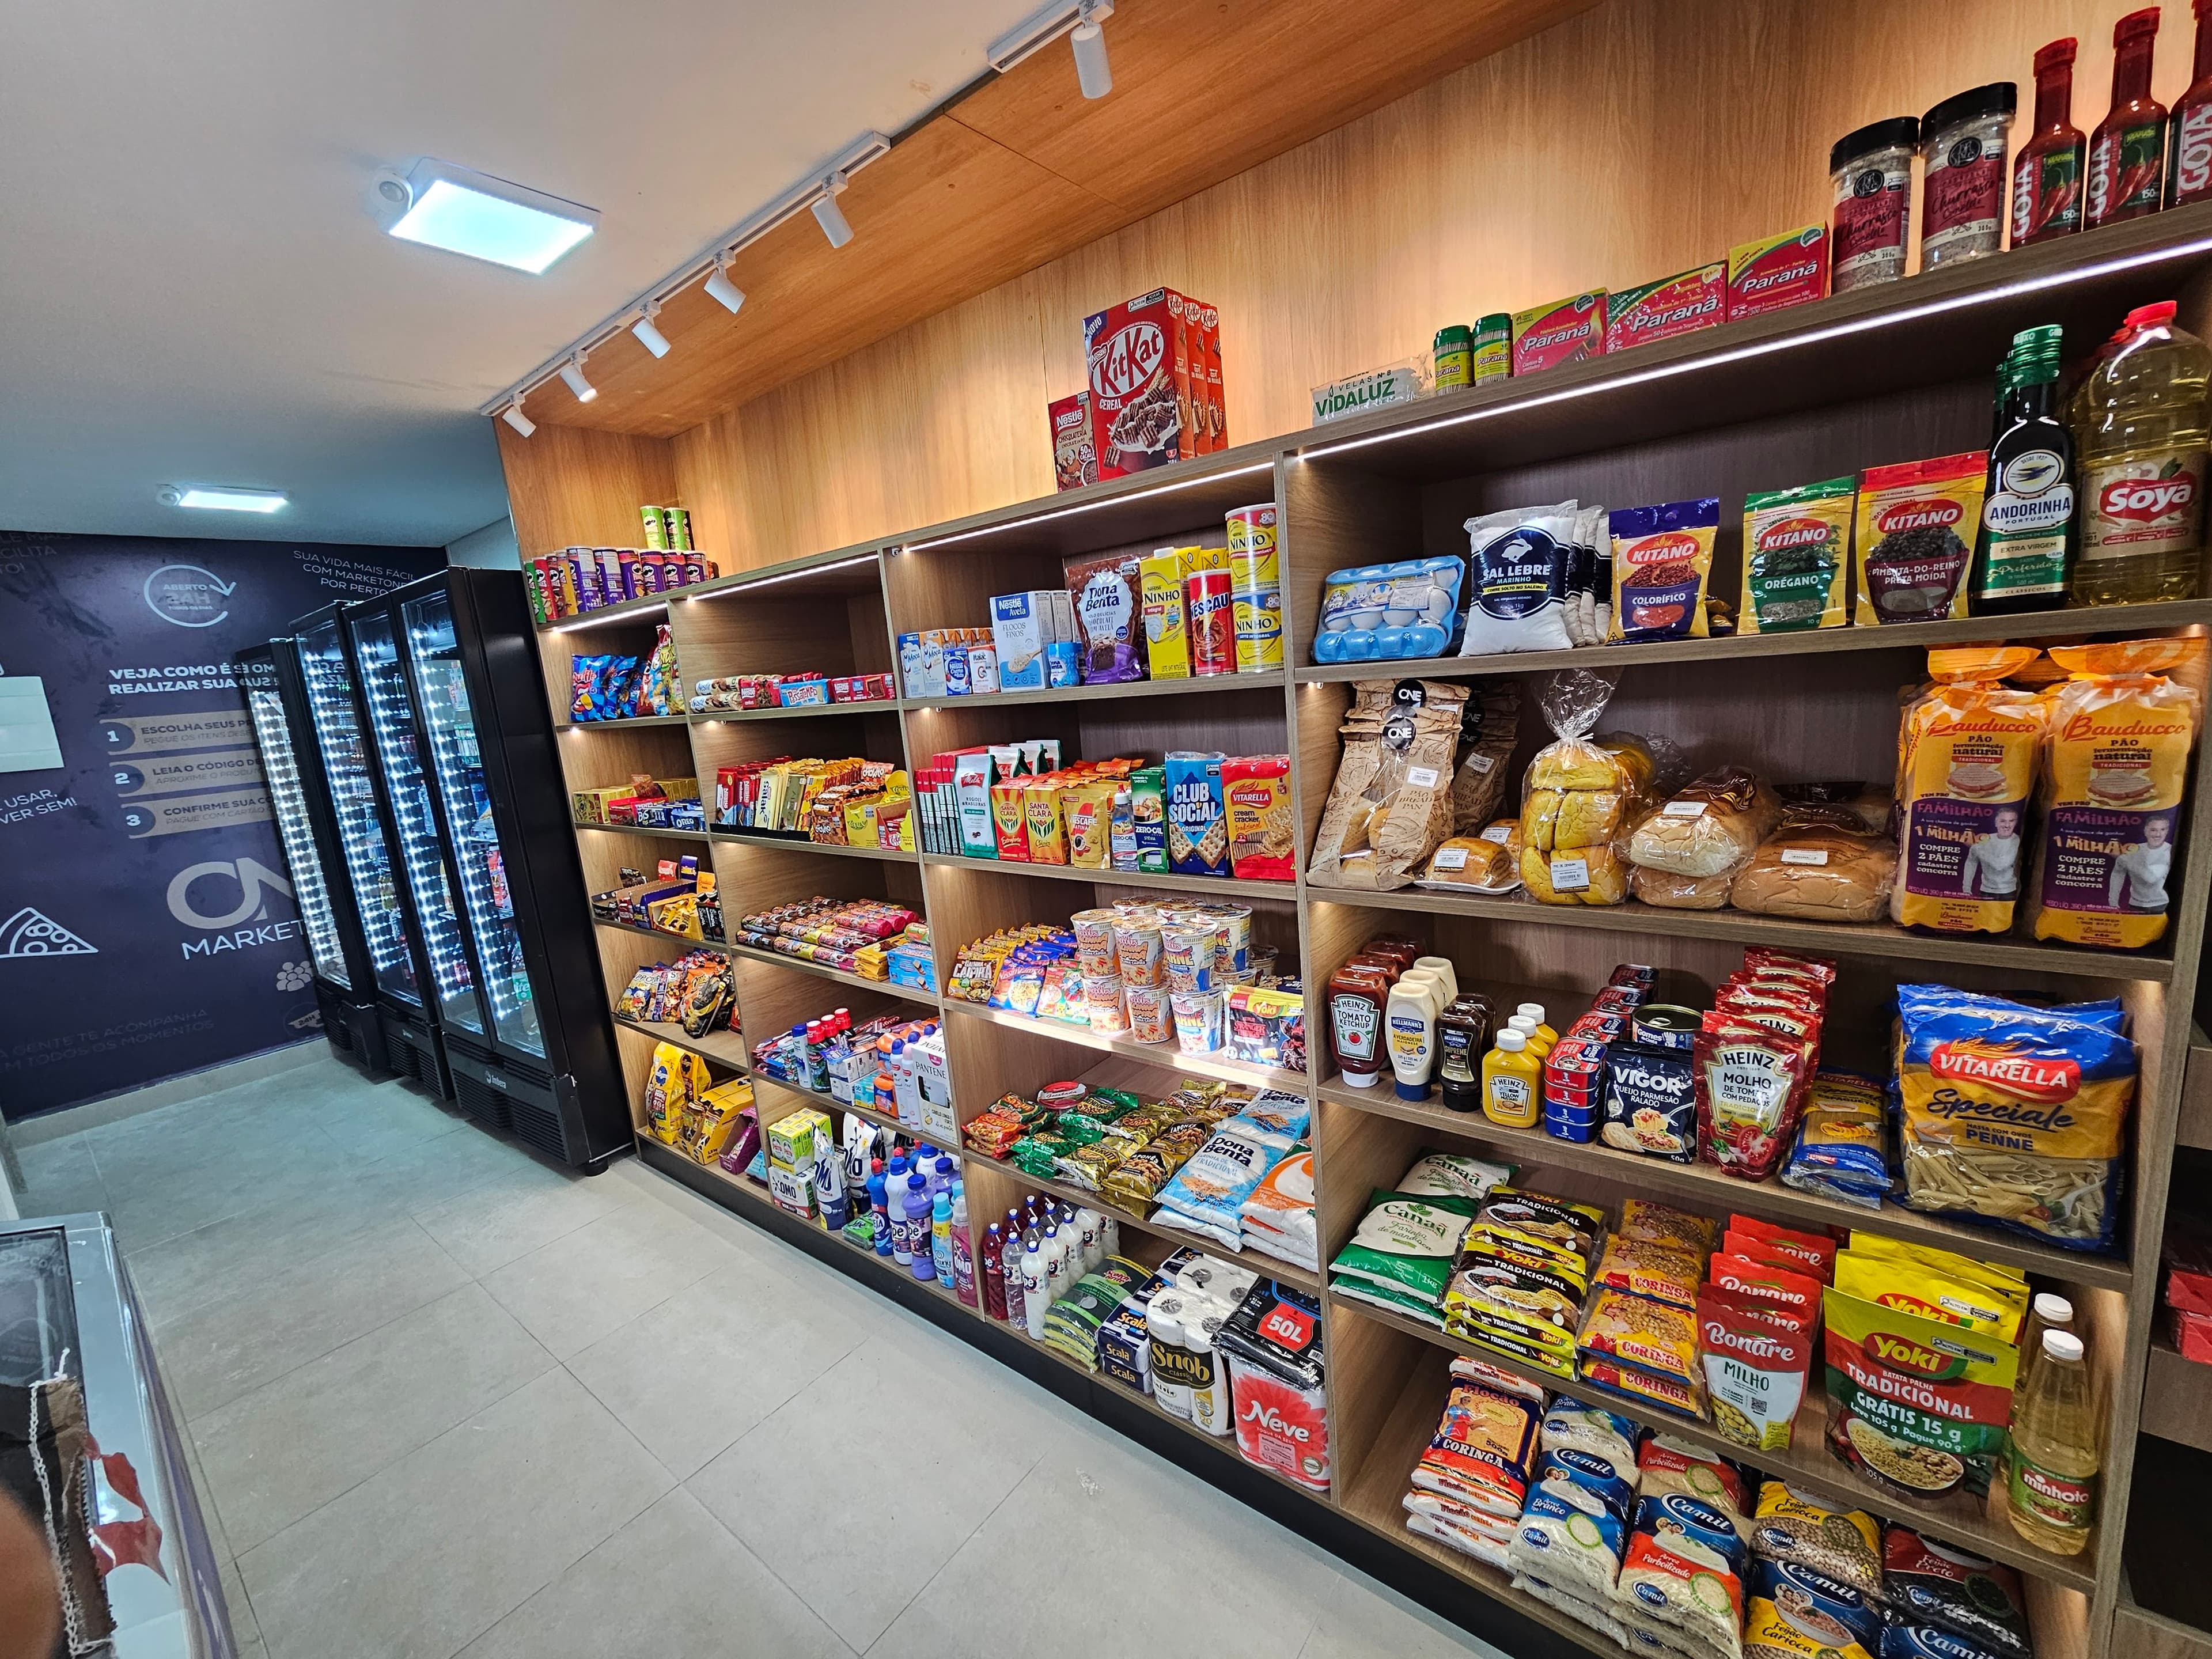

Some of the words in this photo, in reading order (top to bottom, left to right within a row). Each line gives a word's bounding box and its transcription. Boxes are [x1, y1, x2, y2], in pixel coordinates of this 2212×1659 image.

[1743, 260, 1819, 293] Paraná
[1633, 295, 1718, 332] Paraná
[1087, 316, 1102, 338] NOVO
[1524, 322, 1591, 351] Paraná
[1100, 326, 1161, 396] KitKat
[1338, 376, 1372, 392] VELAS
[1099, 397, 1122, 410] CEREAL
[1056, 408, 1083, 427] Nestlé
[2106, 482, 2191, 513] Soya
[1990, 495, 2071, 521] ANDORINHA
[1883, 507, 1959, 532] KITANO
[2006, 514, 2055, 525] PORTUGAL
[1229, 533, 1266, 551] NINHO
[1764, 528, 1828, 548] KITANO
[2000, 543, 2025, 553] EXTRA
[2027, 541, 2056, 552] VIRGEM
[1633, 541, 1696, 563] KITANO
[294, 551, 319, 562] SUA
[323, 556, 351, 568] VIDA
[354, 563, 382, 575] MAIS
[387, 569, 415, 581] FÁCIL
[303, 564, 332, 575] COM
[1483, 568, 1505, 581] SAL
[1507, 565, 1551, 577] LEBRE
[1872, 559, 1961, 576] PIMENTA-DO-REINO
[1497, 575, 1531, 584] MARINHO
[1764, 575, 1819, 590] ORÉGANO
[1915, 571, 1946, 582] MOÍDA
[321, 578, 347, 589] POR
[350, 584, 389, 595] PERTO
[998, 598, 1022, 611] Nestlé
[1085, 593, 1120, 611] Benta
[1144, 589, 1180, 605] NINHO
[1632, 592, 1687, 606] COLORÍFICO
[1190, 593, 1229, 620] NESCAU
[1002, 622, 1026, 631] FLOCOS
[1005, 630, 1024, 639] FINOS
[109, 668, 162, 679] VEJA
[164, 665, 217, 677] COMO
[220, 663, 232, 675] É
[109, 680, 200, 695] REALIZAR
[202, 679, 237, 690] SUA
[107, 730, 119, 743] 1
[141, 724, 202, 734] ESCOLHA
[204, 721, 235, 730] SEUS
[1388, 728, 1412, 739] ONE
[2062, 714, 2187, 742] Bauducco
[2093, 747, 2153, 755] fermentação
[2110, 738, 2139, 747] PÃO
[2093, 752, 2151, 762] natural
[153, 767, 183, 775] LEIA
[196, 759, 244, 770] CÓDIGO
[115, 772, 130, 785] 2
[5, 789, 58, 809] USAR,
[1173, 783, 1210, 802] CLUB
[1232, 792, 1270, 803] VITARELLA
[37, 796, 78, 819] SEM!
[164, 802, 230, 816] CONFIRME
[232, 798, 255, 808] SUA
[1028, 809, 1053, 818] CLARA
[1029, 802, 1050, 810] SANTA
[126, 815, 141, 826] 3
[676, 818, 694, 827] OREO
[2055, 810, 2142, 826] FAMILHÃO
[1181, 825, 1208, 833] ORIGINAL
[2054, 836, 2062, 848] 1
[2059, 854, 2106, 865] COMPRE
[2056, 873, 2094, 881] cadastre
[2057, 865, 2066, 873] 2
[2069, 864, 2104, 875] PÃES
[2055, 880, 2103, 889] concorra
[182, 919, 304, 961] MARKET
[953, 963, 993, 979] CAIPIRA
[1341, 999, 1366, 1011] HEINZ
[299, 1014, 315, 1025] 24H
[1337, 1010, 1371, 1024] TOMATO
[1339, 1018, 1370, 1029] KETCHUP
[1392, 1017, 1423, 1030] HELLMANN'S
[1397, 1035, 1422, 1043] VERDADEIRA
[1637, 1028, 1662, 1043] Gomes
[1444, 1046, 1468, 1056] SUPREME
[1724, 1050, 1777, 1070] HEINZ
[915, 1062, 947, 1079] PANTENE
[1940, 1054, 2069, 1089] VITARELLA
[1497, 1077, 1520, 1088] HEINZ
[1614, 1065, 1684, 1096] VIGOR
[1724, 1071, 1772, 1090] MOLHO
[1724, 1084, 1736, 1093] DE
[1630, 1096, 1660, 1108] RALADO
[1640, 1090, 1680, 1105] PARMESÃO
[1721, 1092, 1737, 1100] COM
[1926, 1088, 2077, 1128] Speciale
[1965, 1128, 2035, 1152] PENNE
[1967, 1122, 1991, 1132] MASSA
[1992, 1127, 2008, 1135] COM
[2010, 1131, 2032, 1140] OVOS
[1203, 1143, 1252, 1168] Benta
[1213, 1136, 1255, 1157] Dona
[1383, 1202, 1448, 1238] Canaã
[1515, 1195, 1581, 1227] TRADICIONAL
[1378, 1225, 1389, 1234] de
[1500, 1249, 1546, 1268] Yoki
[1421, 1274, 1439, 1289] 1kg
[1494, 1260, 1567, 1291] TRADICIONAL
[1267, 1314, 1302, 1343] 50L
[1493, 1317, 1529, 1335] TRADICIONAL
[1705, 1321, 1796, 1362] Bonare
[1106, 1343, 1131, 1361] Scala
[1875, 1337, 1941, 1372] Yoki
[1152, 1343, 1211, 1382] Snob
[1111, 1365, 1136, 1383] Scala
[1724, 1360, 1770, 1392] MILHO
[1882, 1370, 1908, 1383] BATATA
[1910, 1378, 1934, 1391] PALHA
[1461, 1382, 1520, 1407] Flocão
[1625, 1372, 1691, 1404] CORINGA
[1846, 1362, 1975, 1419] TRADICIONAL
[1242, 1400, 1310, 1444] Neve
[1850, 1402, 1869, 1416] Leve
[1869, 1413, 1889, 1428] 105
[1891, 1422, 1898, 1433] g
[1902, 1426, 1936, 1445] Pague
[1936, 1439, 1953, 1450] 90
[1855, 1391, 1915, 1426] GRÁTIS
[1922, 1416, 1942, 1434] 15
[1950, 1428, 1962, 1444] g
[1442, 1438, 1505, 1468] CORINGA
[1558, 1449, 1612, 1476] Camil
[2022, 1471, 2090, 1503] minhoto
[1532, 1498, 1566, 1516] Branco
[1669, 1496, 1731, 1532] Camil
[1774, 1503, 1820, 1522] Carioca
[1642, 1553, 1690, 1578] Parboilizado
[1788, 1562, 1857, 1602] Camil
[1634, 1583, 1665, 1603] Camil
[1773, 1622, 1802, 1640] Feijão
